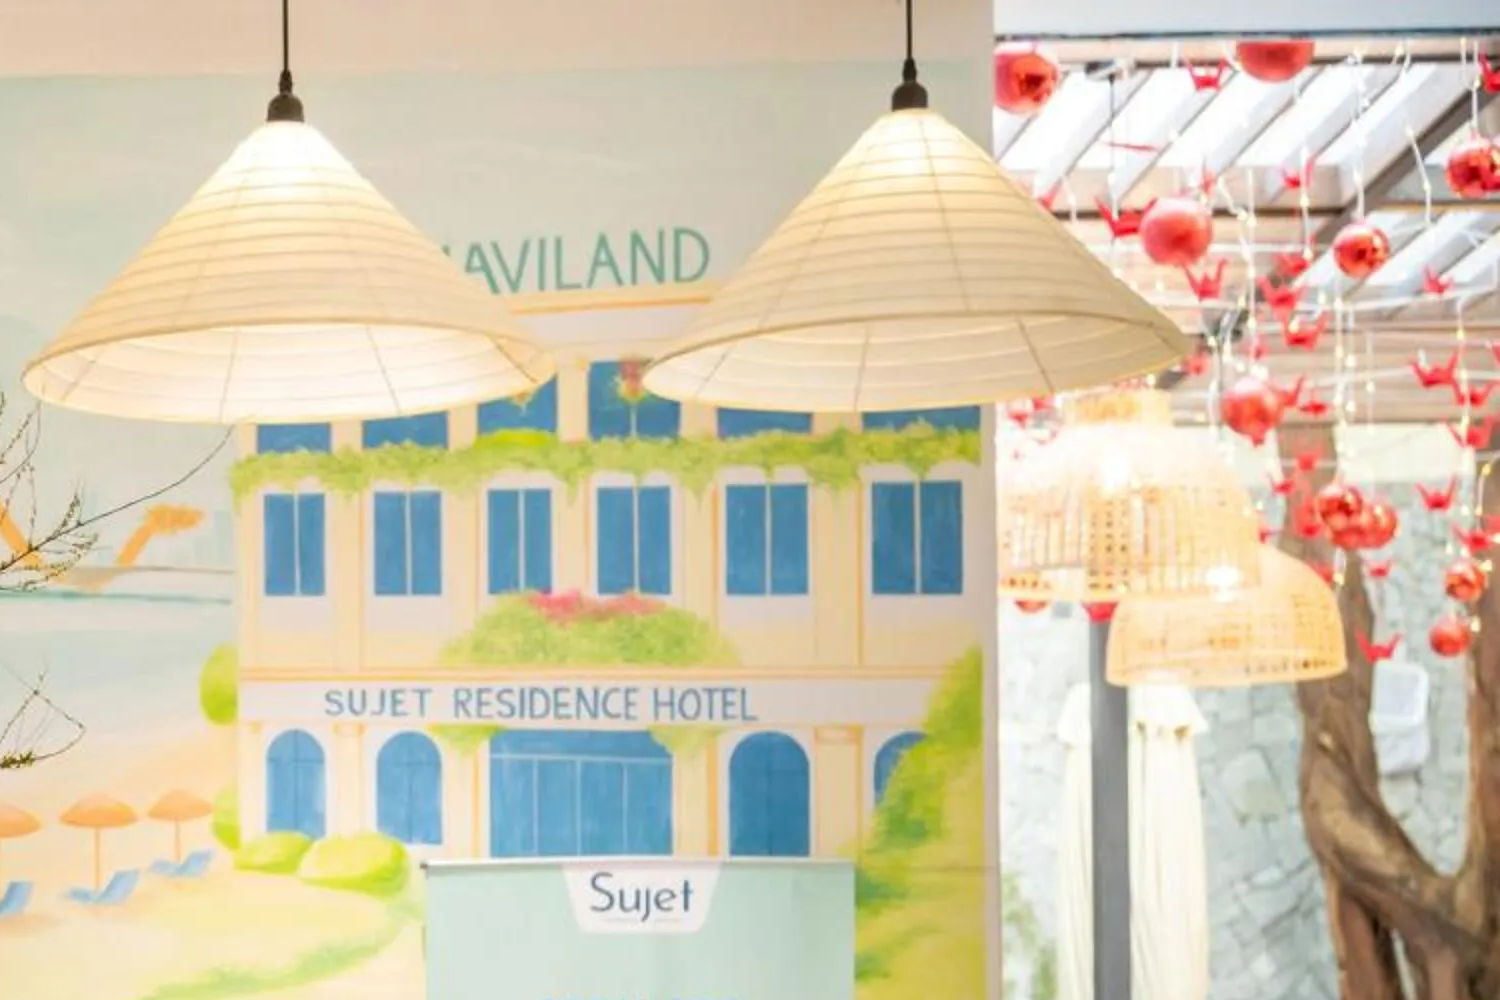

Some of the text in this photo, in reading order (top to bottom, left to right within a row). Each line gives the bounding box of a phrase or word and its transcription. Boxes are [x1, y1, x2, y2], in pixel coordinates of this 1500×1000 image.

[442, 227, 710, 295] AVILAND
[324, 686, 758, 721] SUJET RESIDENCE HOTEL
[590, 871, 694, 922] Sujet
